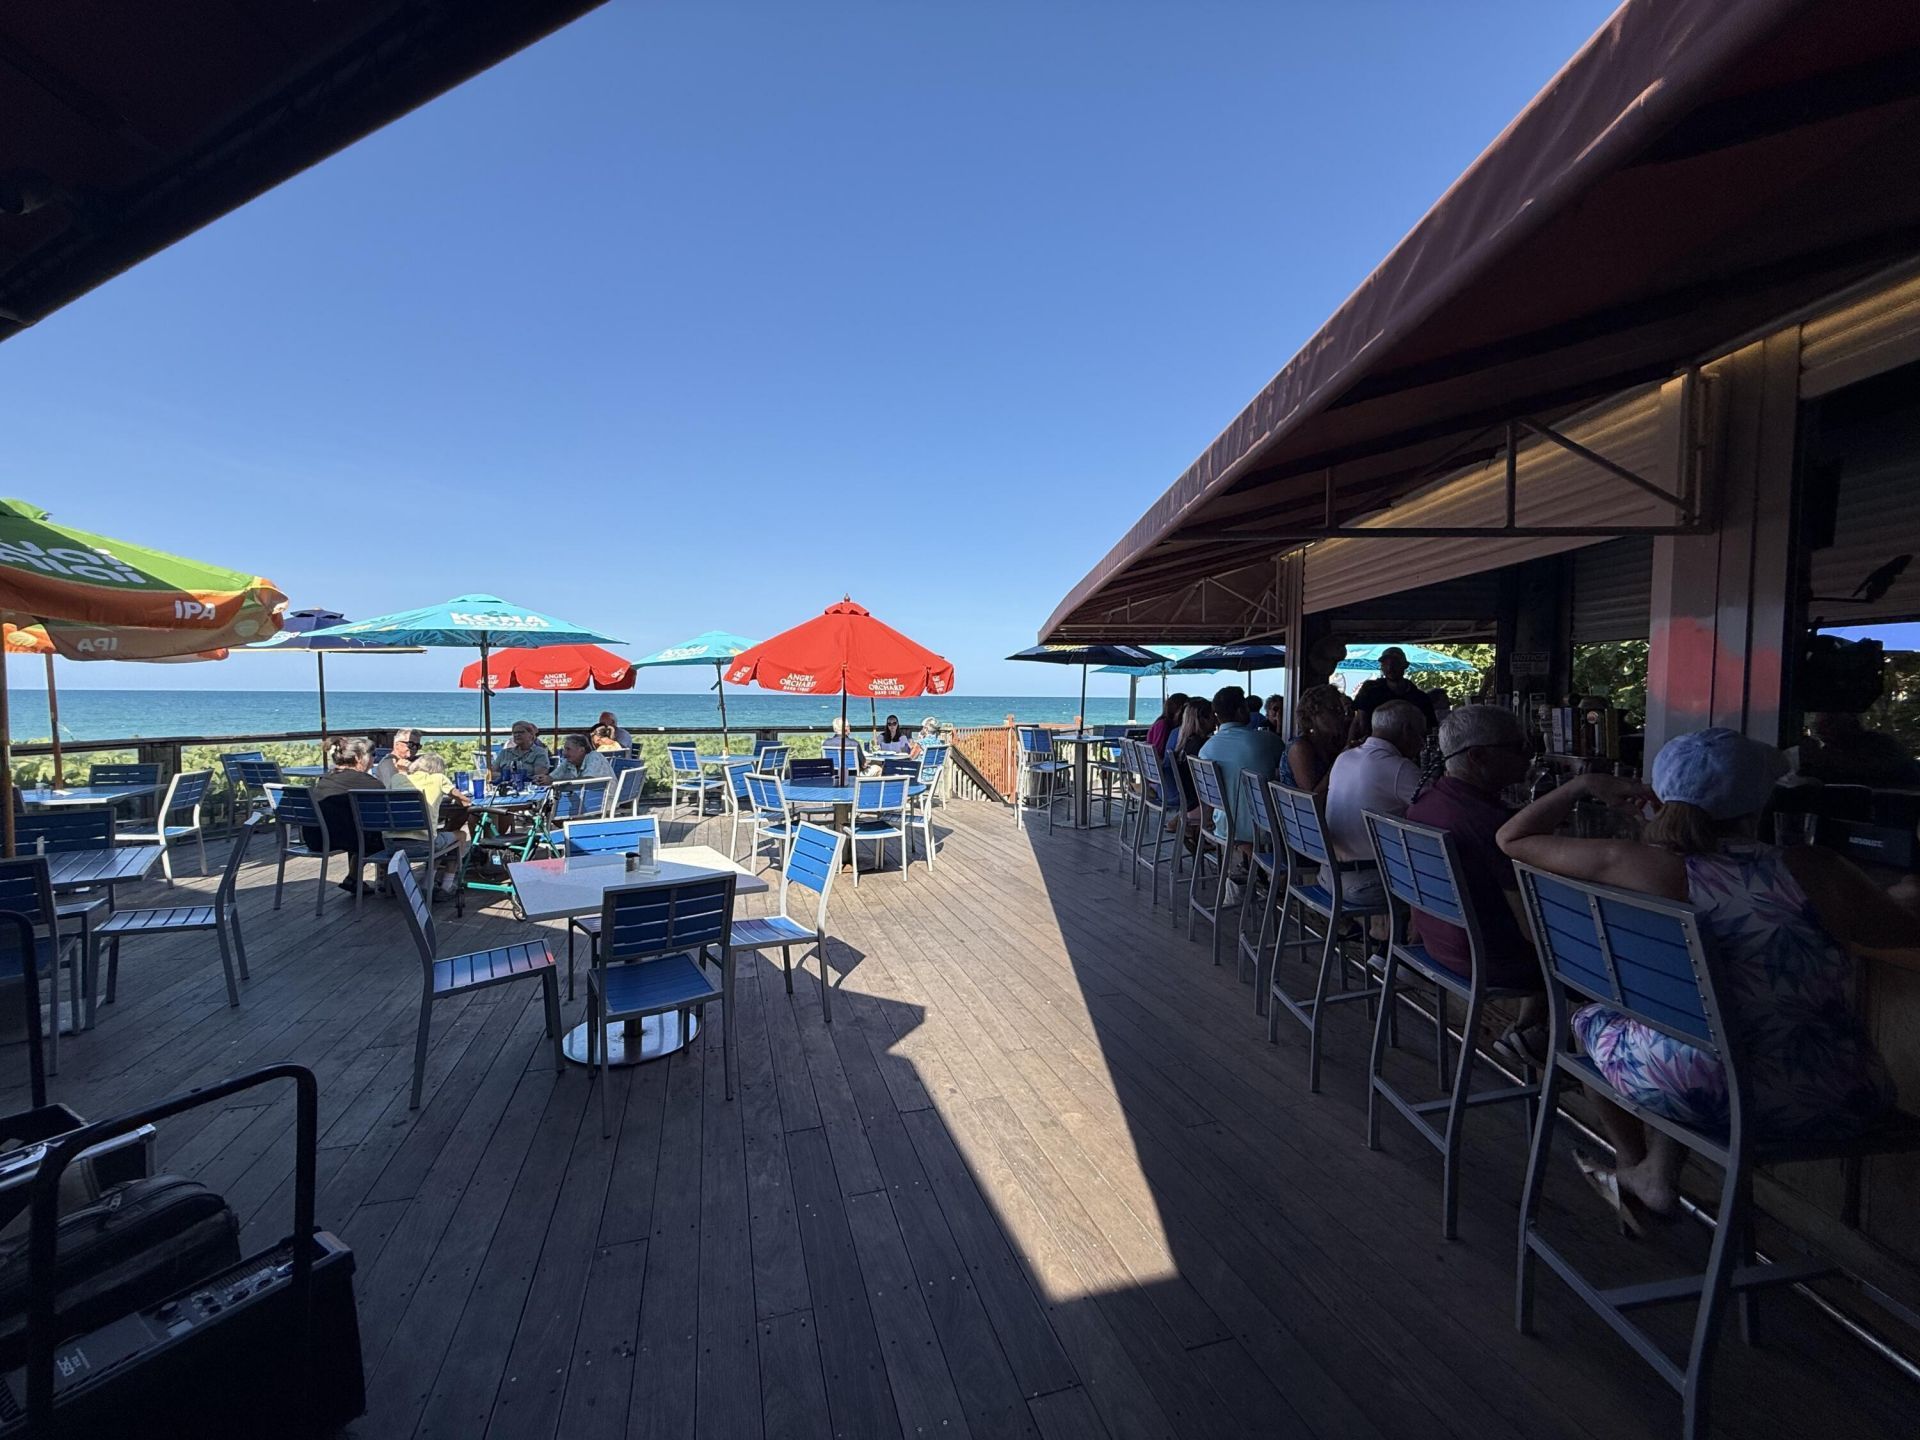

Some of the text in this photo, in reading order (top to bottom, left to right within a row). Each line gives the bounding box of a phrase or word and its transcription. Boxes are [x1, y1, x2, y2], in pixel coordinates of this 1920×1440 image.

[174, 600, 216, 620] IPA
[450, 612, 546, 624] KONA
[787, 672, 815, 682] ANGRY
[779, 678, 818, 687] ORCHARD
[872, 678, 898, 686] ANGRY
[868, 683, 905, 691] ORCHARD
